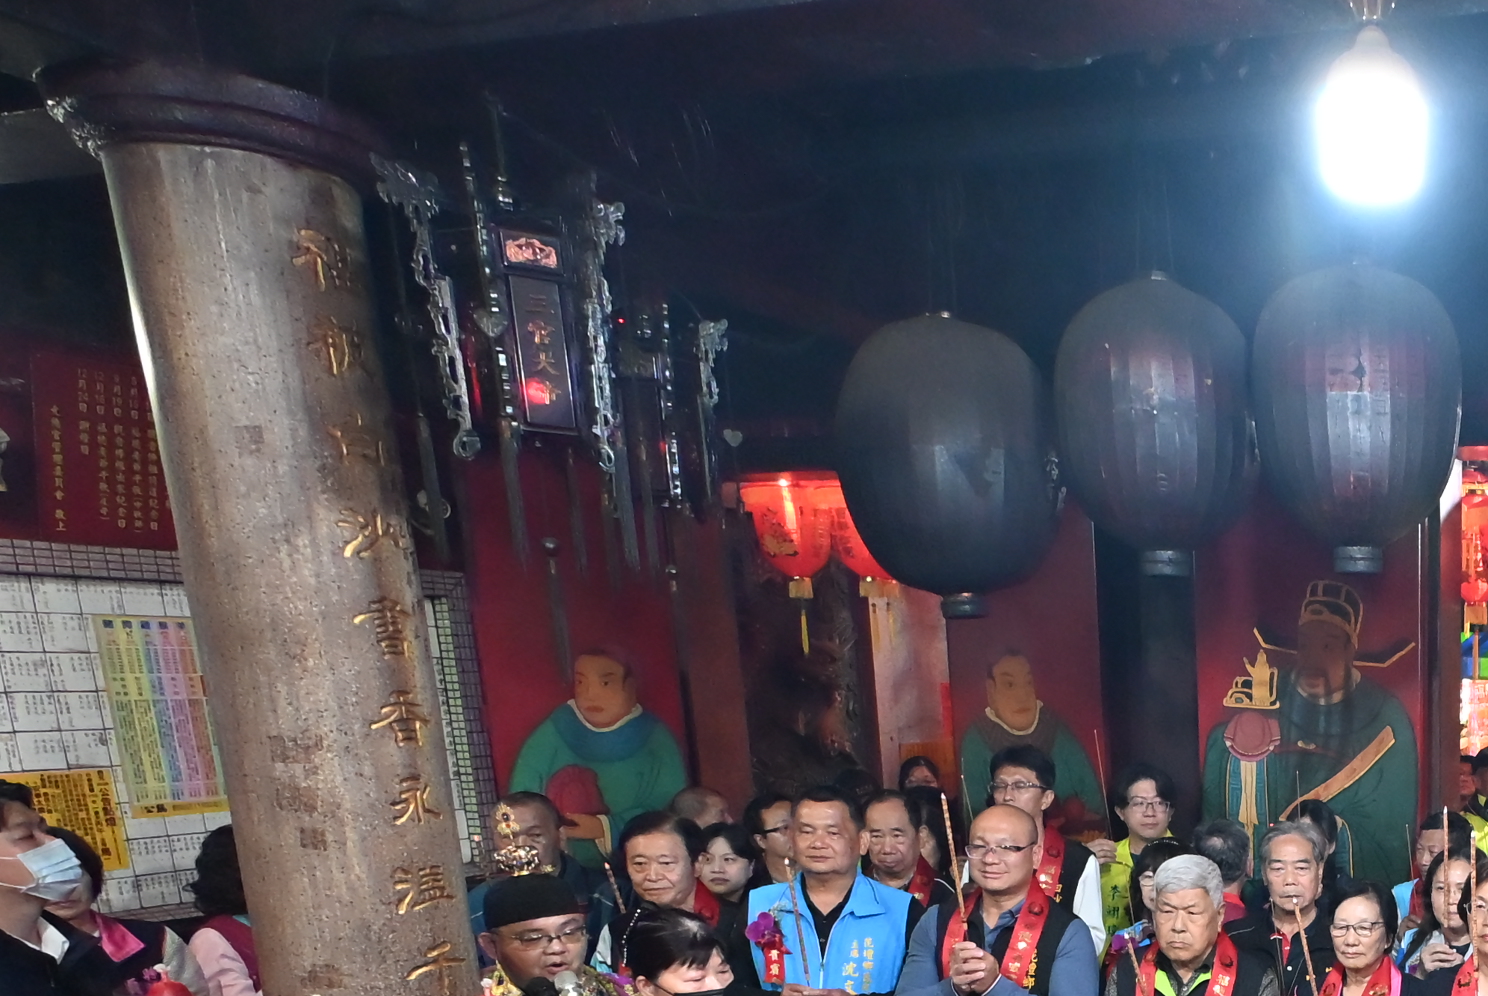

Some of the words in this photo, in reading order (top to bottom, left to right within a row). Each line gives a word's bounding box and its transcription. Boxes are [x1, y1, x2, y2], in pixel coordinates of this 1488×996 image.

[525, 294, 561, 405] 三官大帝
[769, 949, 780, 976] 貴賓
